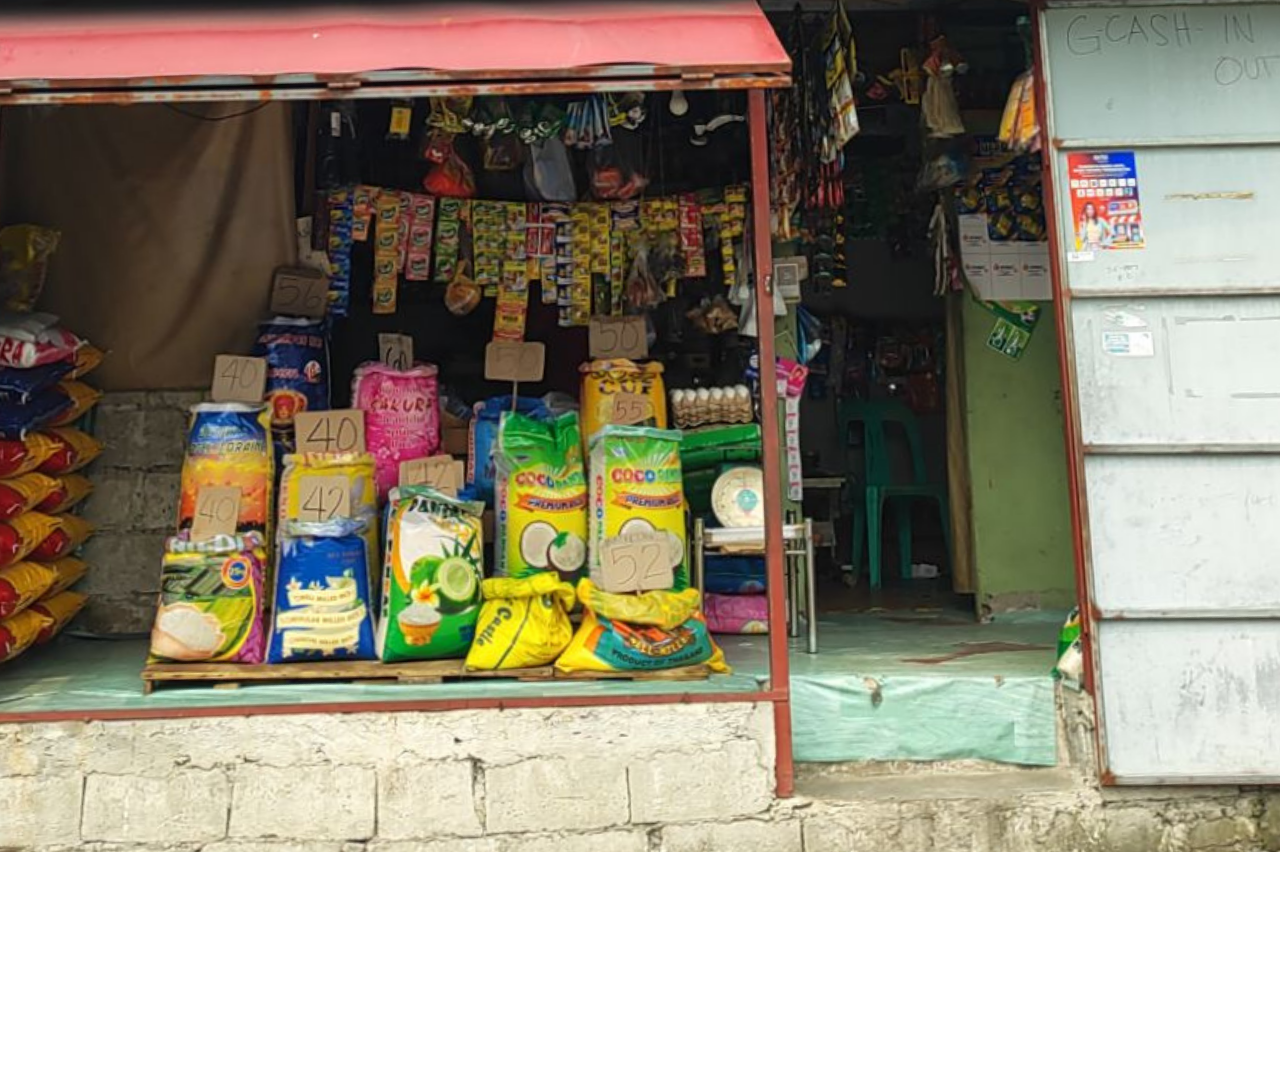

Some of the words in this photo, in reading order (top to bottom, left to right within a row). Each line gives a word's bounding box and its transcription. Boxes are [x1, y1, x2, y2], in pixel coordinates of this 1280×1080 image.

[1224, 13, 1255, 44] IN
[220, 357, 257, 391] 40
[305, 415, 358, 453] 40
[198, 496, 235, 525] 40
[302, 485, 345, 523] 42
[610, 540, 666, 586] 52
